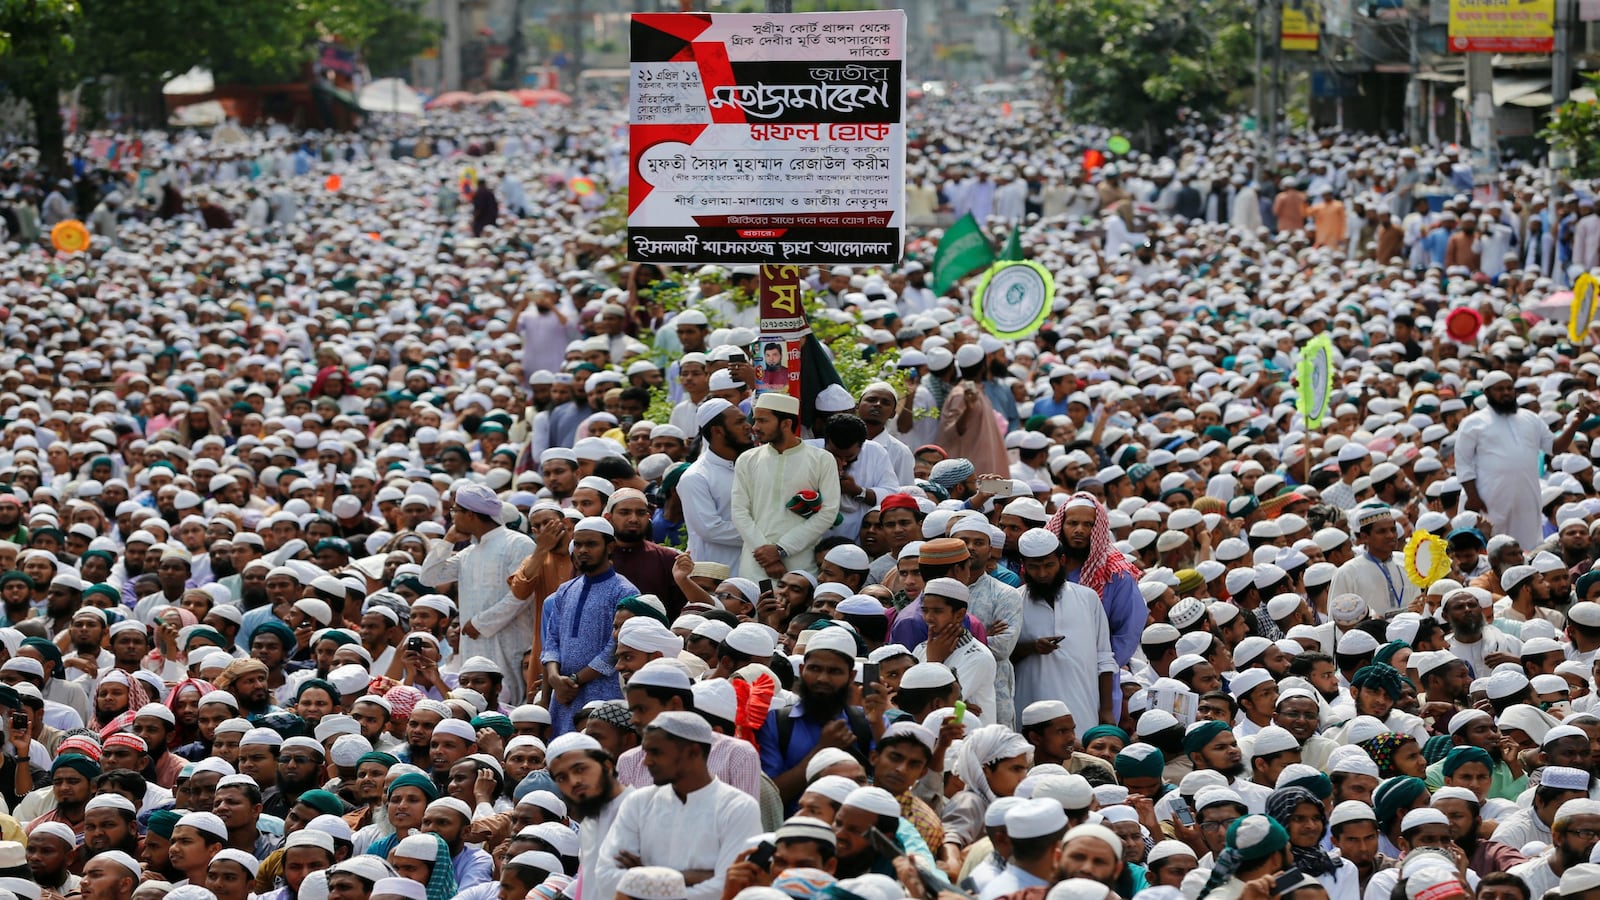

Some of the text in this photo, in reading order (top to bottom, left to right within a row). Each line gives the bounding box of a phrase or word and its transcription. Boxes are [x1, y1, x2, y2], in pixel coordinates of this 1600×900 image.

[752, 22, 784, 35] সুপ্রীম
[790, 22, 818, 34] কোর্ট
[860, 23, 890, 33] থেকে
[732, 34, 890, 48] গ্রিক দেবীর মূর্তি অপসারণের
[850, 46, 890, 57] দাবিতে
[638, 69, 652, 82] ২১
[656, 68, 679, 80] এপ্রিল
[808, 64, 889, 82] জাতীয়
[638, 93, 675, 104] ঐতিহাসিক
[709, 81, 890, 119] মহাসমাবেশ
[750, 123, 890, 141] সফল হোক
[800, 145, 850, 154] সভাপতিত্ব
[648, 154, 890, 173] মুফতী সৈয়দ মুহাম্মাদ রেজাউল করীম
[674, 195, 696, 206] শীর্ষ
[700, 197, 784, 206] ওলামা-মাশায়েখ
[803, 195, 840, 206] জাতীয়
[846, 198, 888, 209] নেতৃবৃন্দ
[796, 216, 816, 224] দলে
[819, 216, 839, 224] দলে
[868, 216, 885, 225] দিন
[632, 235, 892, 259] ইসলামী শাসনতন্ত্র ছাত্র আন্দোলন
